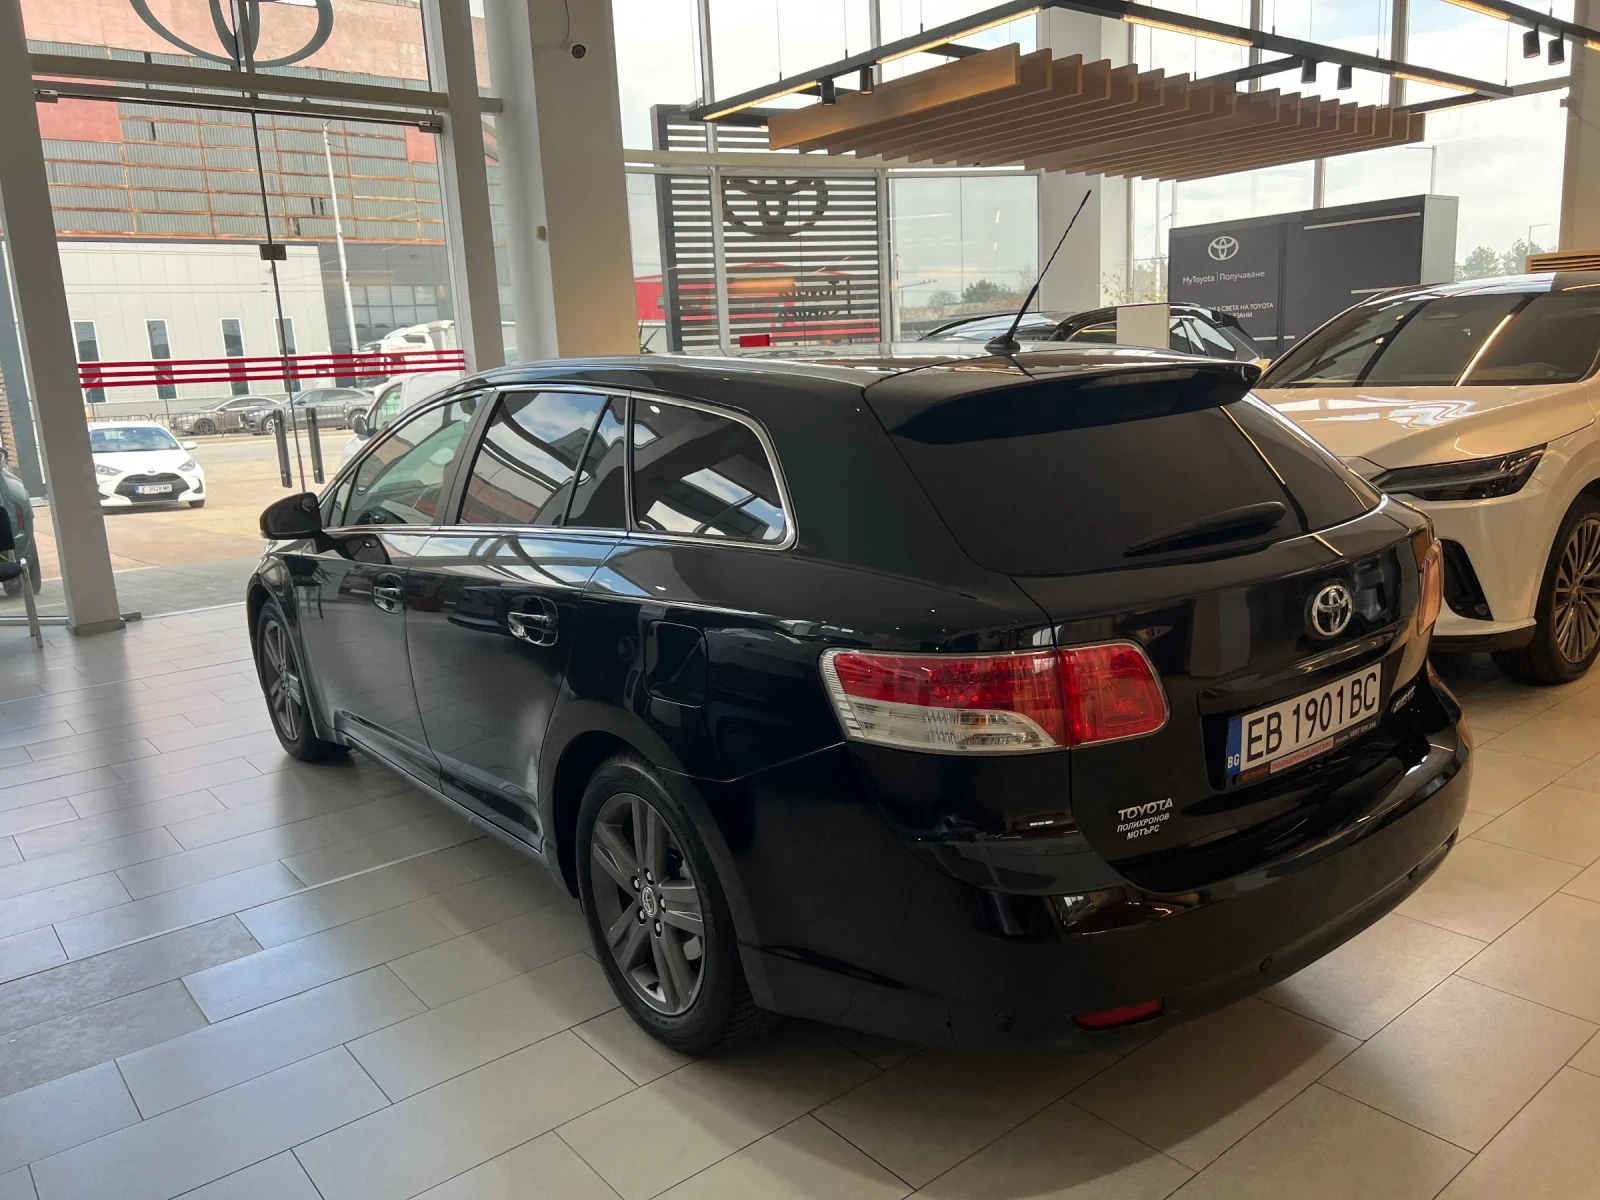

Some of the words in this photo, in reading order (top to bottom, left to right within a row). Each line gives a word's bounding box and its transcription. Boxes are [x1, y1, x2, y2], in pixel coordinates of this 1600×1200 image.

[1182, 275, 1215, 286] MyToyota
[1219, 270, 1266, 282] Получаване
[1221, 304, 1239, 312] СВЕТА
[1240, 303, 1249, 311] НА
[1249, 302, 1274, 310] TOYOTA
[1247, 712, 1283, 763] EB
[1292, 686, 1344, 744] 1901
[1349, 672, 1377, 719] BC
[1227, 753, 1240, 769] BG
[1117, 797, 1174, 822] TOYOTA
[1116, 812, 1170, 833] ПОЛИХРОНОВ
[1126, 824, 1160, 840] МОТЪРС
